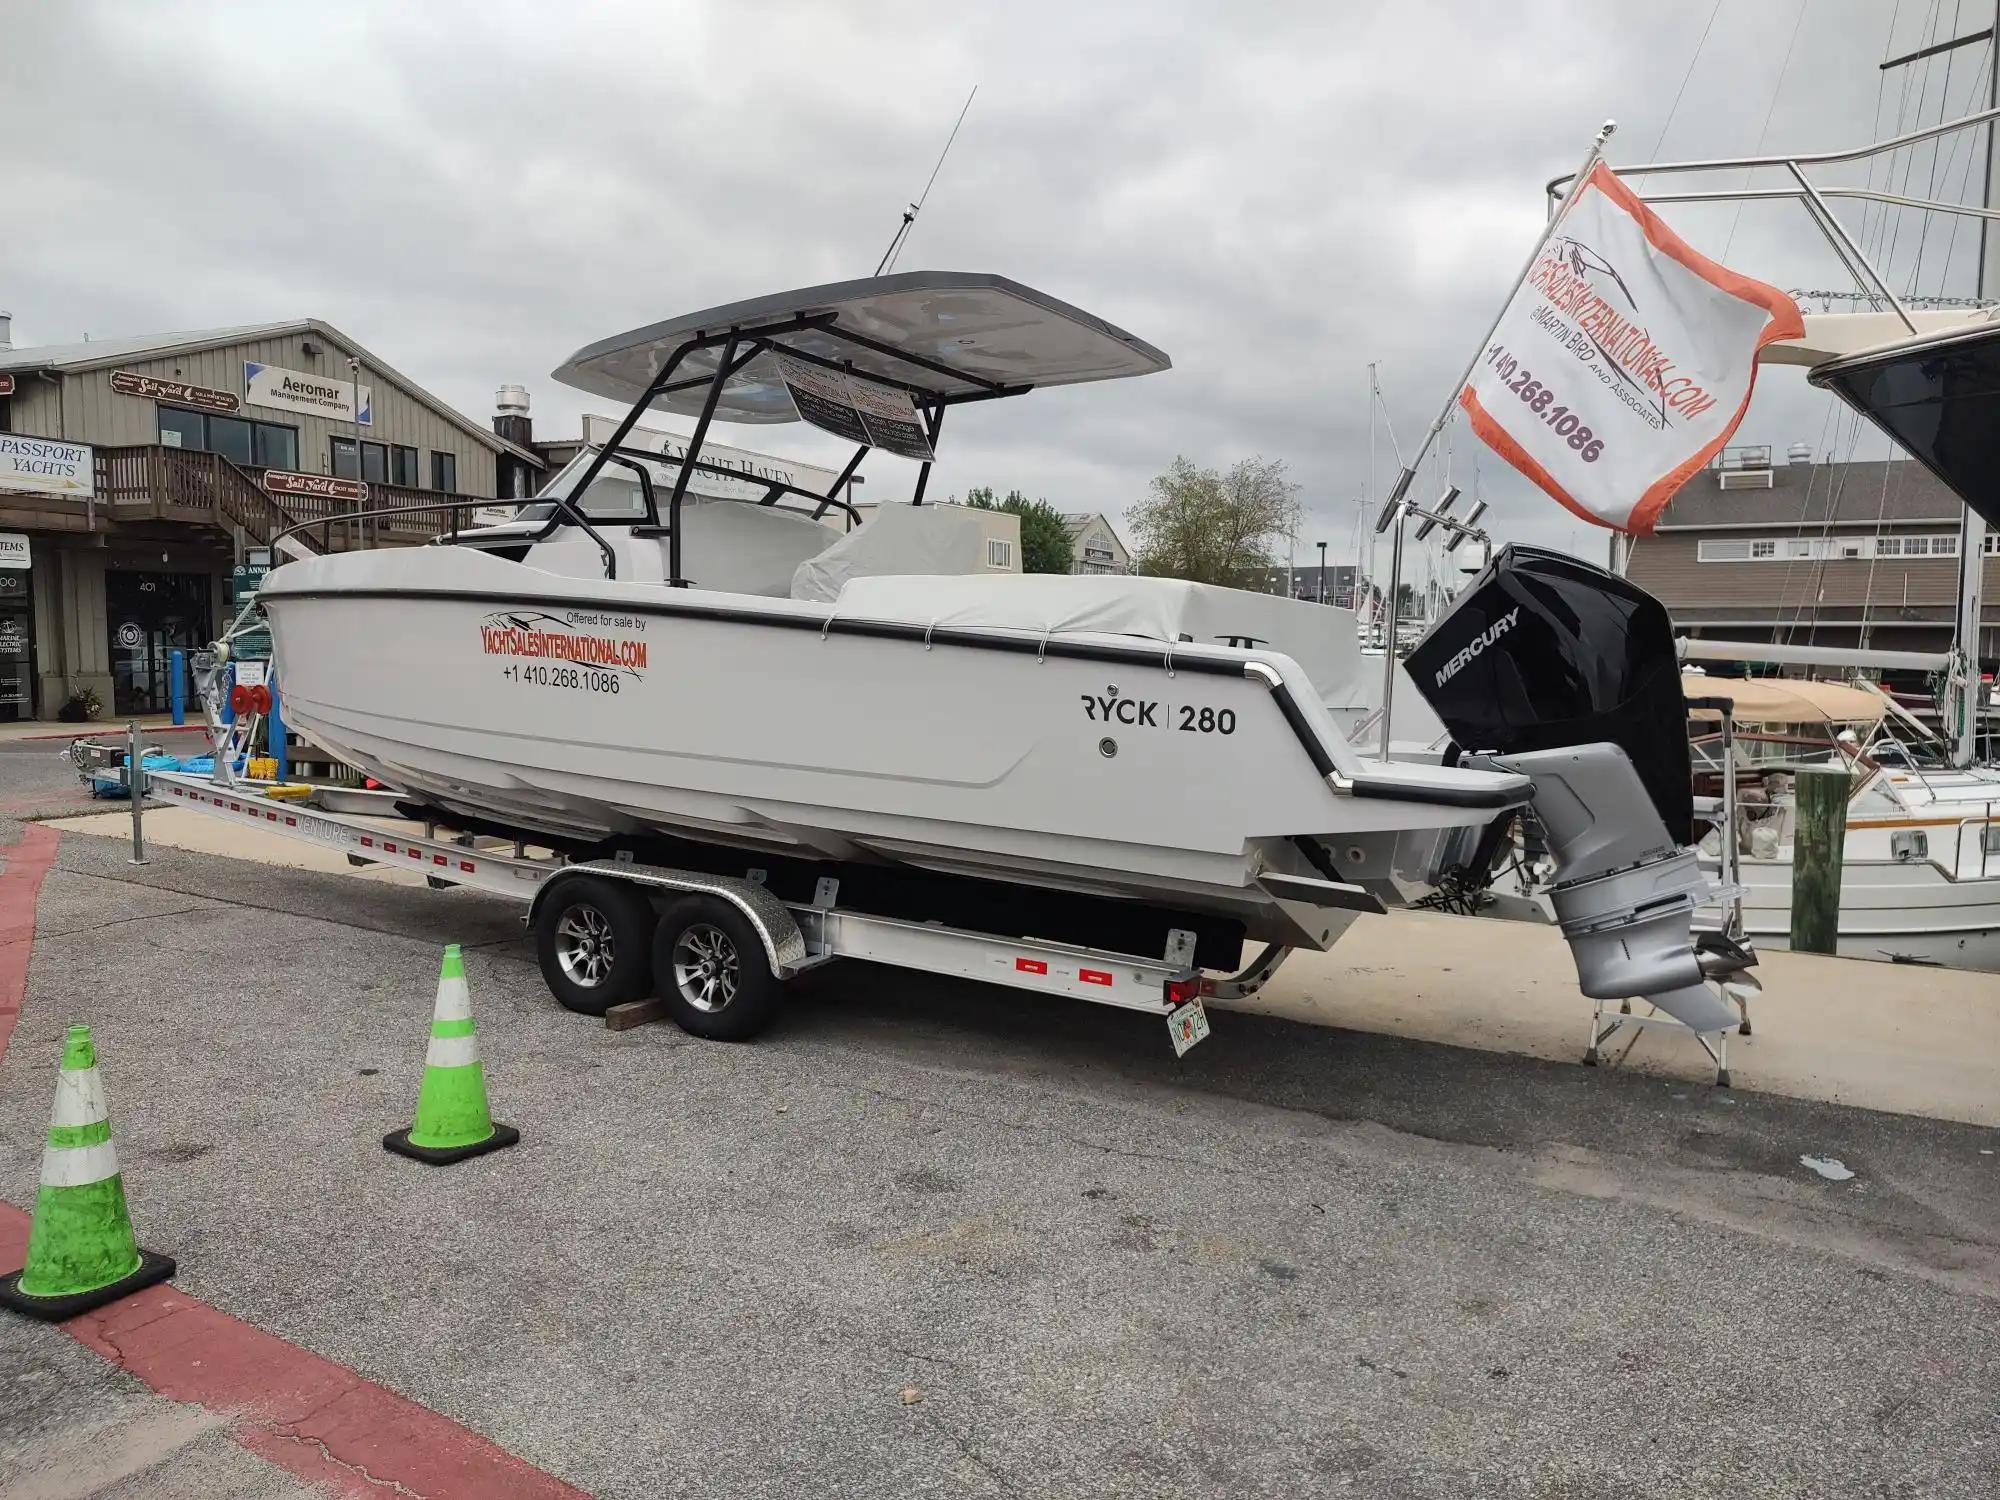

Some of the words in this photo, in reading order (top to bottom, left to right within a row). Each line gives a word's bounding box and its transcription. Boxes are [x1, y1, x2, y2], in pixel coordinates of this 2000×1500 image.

[282, 376, 340, 400] Aeromar
[1564, 331, 1596, 361] BIRD
[1588, 363, 1612, 384] AND
[1608, 383, 1661, 430] ASSOCIATES
[270, 389, 318, 405] Management
[318, 400, 350, 412] Company
[1495, 352, 1605, 463] 410.268.1086
[0, 439, 86, 462] PASSPORT
[12, 457, 76, 477] YACHTS
[285, 476, 305, 489] Sail
[305, 478, 328, 491] Yard
[139, 582, 156, 593] 401
[566, 611, 598, 625] Offered
[600, 613, 612, 626] for
[614, 616, 633, 628] sale
[635, 617, 647, 631] by
[1435, 606, 1520, 688] MERCURY
[503, 665, 519, 683] +1
[523, 666, 620, 694] 410.268.1086
[1081, 694, 1159, 728] RYCK
[1179, 705, 1236, 735] 280
[297, 814, 348, 844] VENTURE
